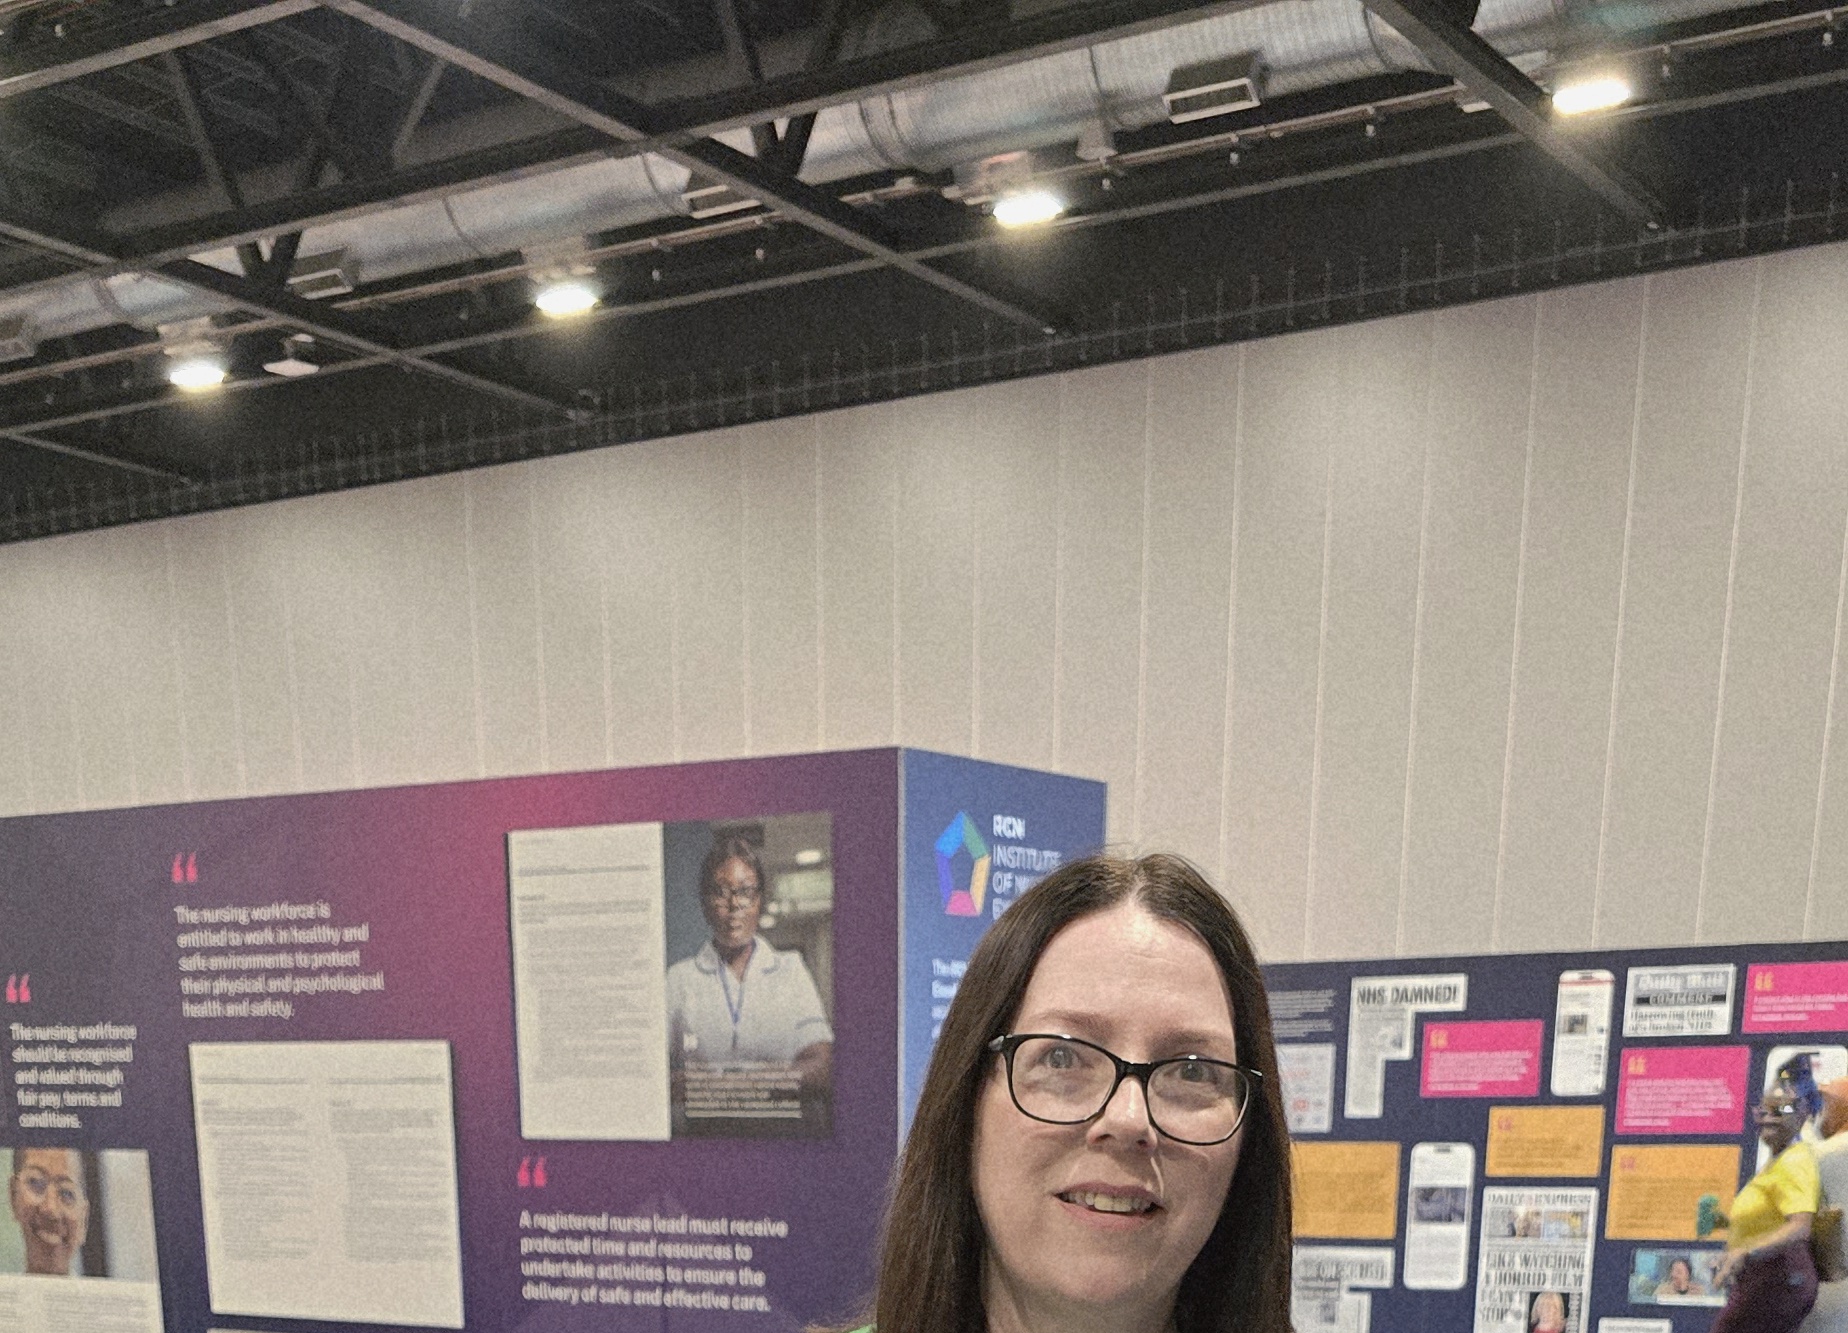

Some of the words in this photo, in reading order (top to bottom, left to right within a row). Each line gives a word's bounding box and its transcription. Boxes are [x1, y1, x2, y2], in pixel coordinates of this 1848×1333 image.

[993, 814, 1025, 840] RCN
[993, 844, 1061, 871] INSTITUTE
[200, 904, 250, 925] nursing
[250, 901, 316, 921] workforce
[1357, 986, 1385, 1004] NHS
[1390, 985, 1457, 1003] DAMNED!
[519, 1210, 532, 1229] A
[533, 1211, 609, 1233] registered
[609, 1216, 652, 1233] nurse
[653, 1213, 688, 1234] lead
[689, 1218, 728, 1236] must
[730, 1217, 788, 1238] receive
[520, 1236, 591, 1255] protected
[592, 1237, 627, 1256] time
[627, 1238, 657, 1258] and
[658, 1242, 733, 1261] resources
[734, 1242, 753, 1261] to
[521, 1258, 595, 1279] undertake
[597, 1262, 665, 1283] activities
[666, 1265, 683, 1283] to
[684, 1268, 737, 1285] ensure
[738, 1267, 766, 1287] the
[522, 1280, 580, 1305] delivery
[581, 1285, 598, 1304] of
[599, 1285, 632, 1305] safe
[632, 1286, 662, 1306] and
[663, 1287, 730, 1309] effective
